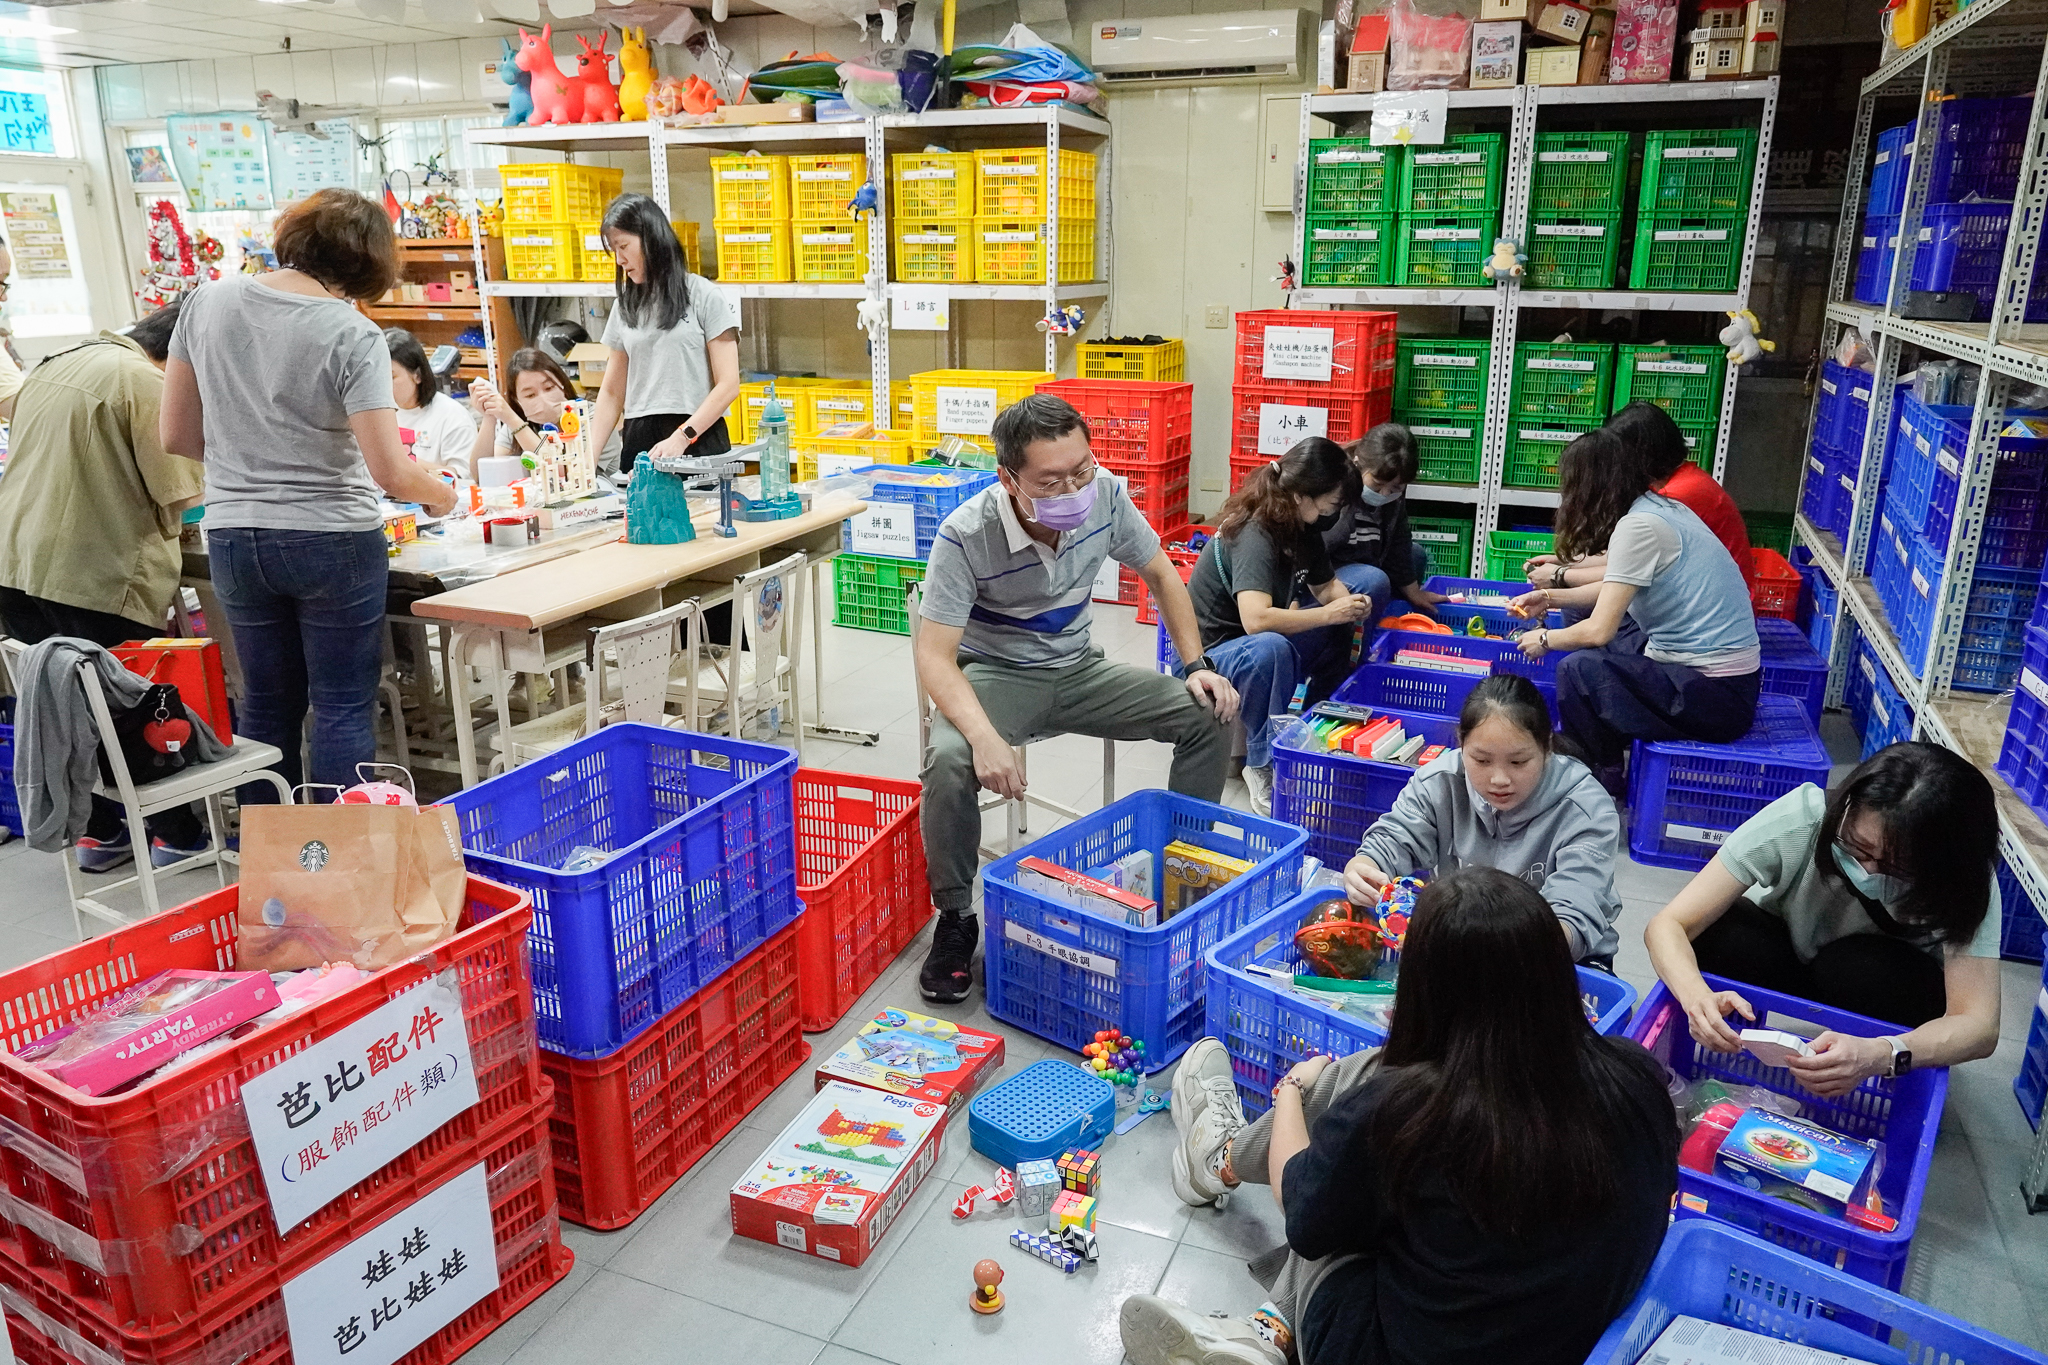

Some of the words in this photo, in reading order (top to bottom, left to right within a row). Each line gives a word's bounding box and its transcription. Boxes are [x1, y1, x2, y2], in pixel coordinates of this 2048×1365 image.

[904, 300, 909, 310] L
[916, 301, 936, 311] 語言
[1278, 414, 1308, 431] 小車
[857, 530, 879, 539] Jigsaw
[883, 533, 910, 541] puzzles
[871, 516, 892, 529] 拼圖
[441, 820, 460, 861] STARBUCKS
[1026, 933, 1042, 949] F-3
[1048, 944, 1090, 967] 手眼協調
[127, 1014, 196, 1059] PARTY
[171, 1019, 228, 1051] TRENDY
[277, 1006, 444, 1129] 芭比配件
[883, 1094, 915, 1109] Pegs
[915, 1104, 938, 1114] 600
[1764, 1115, 1832, 1142] Magical
[361, 1227, 430, 1289] 娃娃
[333, 1248, 468, 1355] 芭比娃娃
